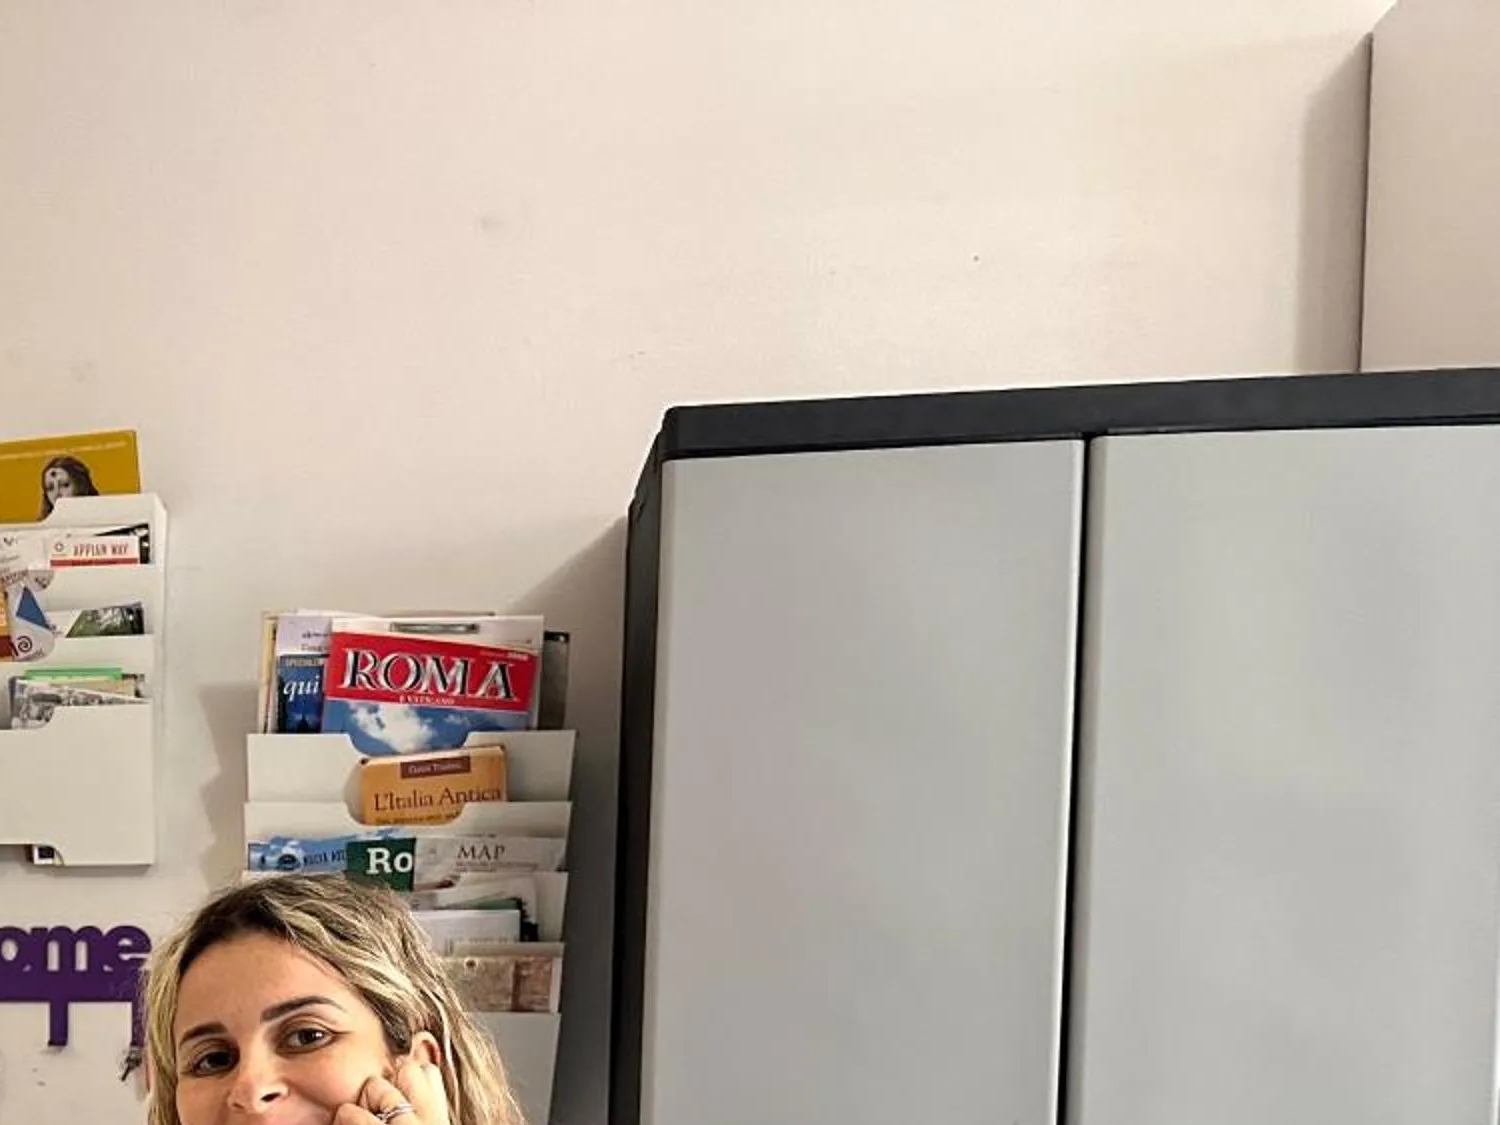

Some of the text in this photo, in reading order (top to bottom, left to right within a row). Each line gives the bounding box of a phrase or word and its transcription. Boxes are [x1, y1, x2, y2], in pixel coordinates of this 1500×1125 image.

[337, 647, 517, 702] ROMA
[283, 675, 319, 702] qui
[374, 786, 501, 811] L'Italia Antica
[366, 847, 413, 875] Ro
[457, 844, 506, 860] MAP
